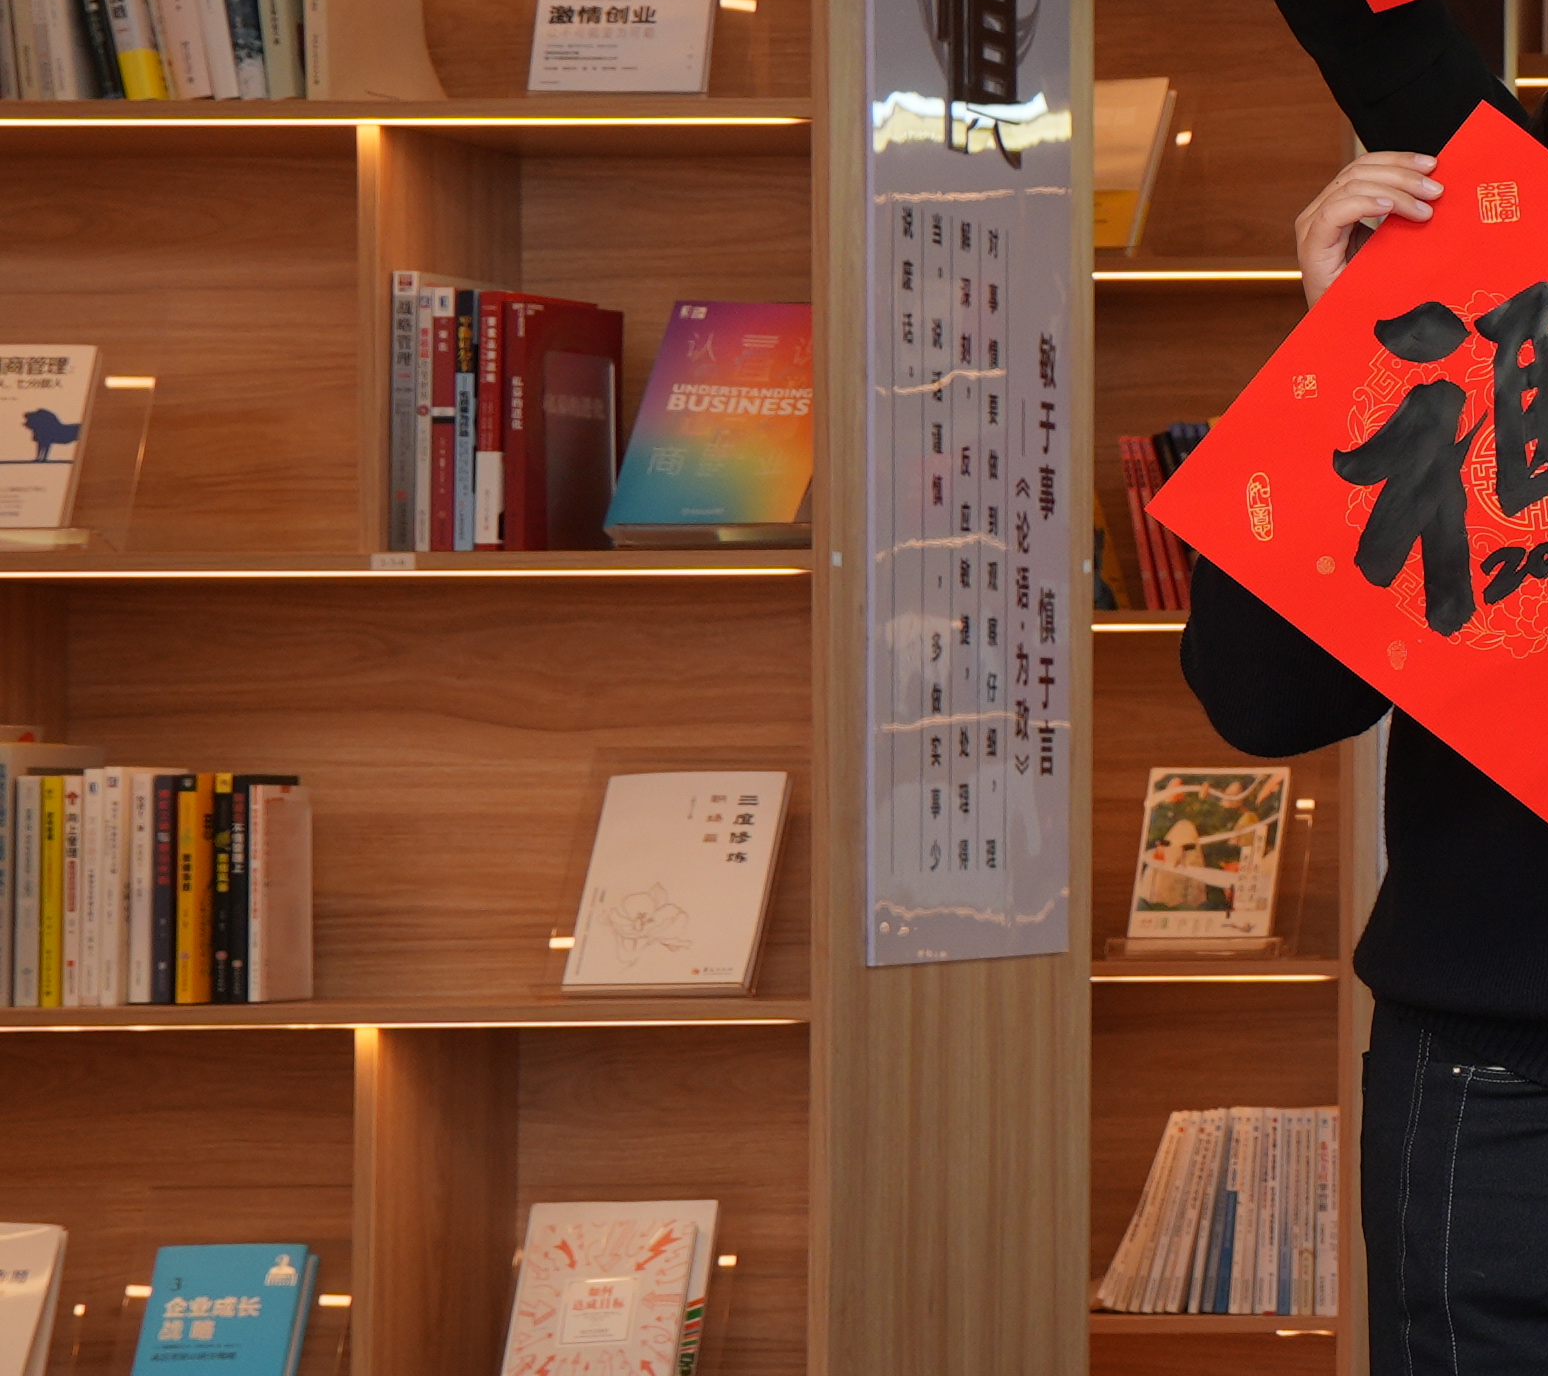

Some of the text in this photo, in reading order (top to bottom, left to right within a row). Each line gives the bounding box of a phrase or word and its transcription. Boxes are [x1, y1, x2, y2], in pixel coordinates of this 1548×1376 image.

[548, 5, 657, 25] 激情创业
[672, 383, 813, 399] UNDERSTANDING
[666, 394, 811, 416] BUSINESS
[1036, 332, 1057, 777] 敏于事 慎于言
[163, 1296, 262, 1318] 企业成长
